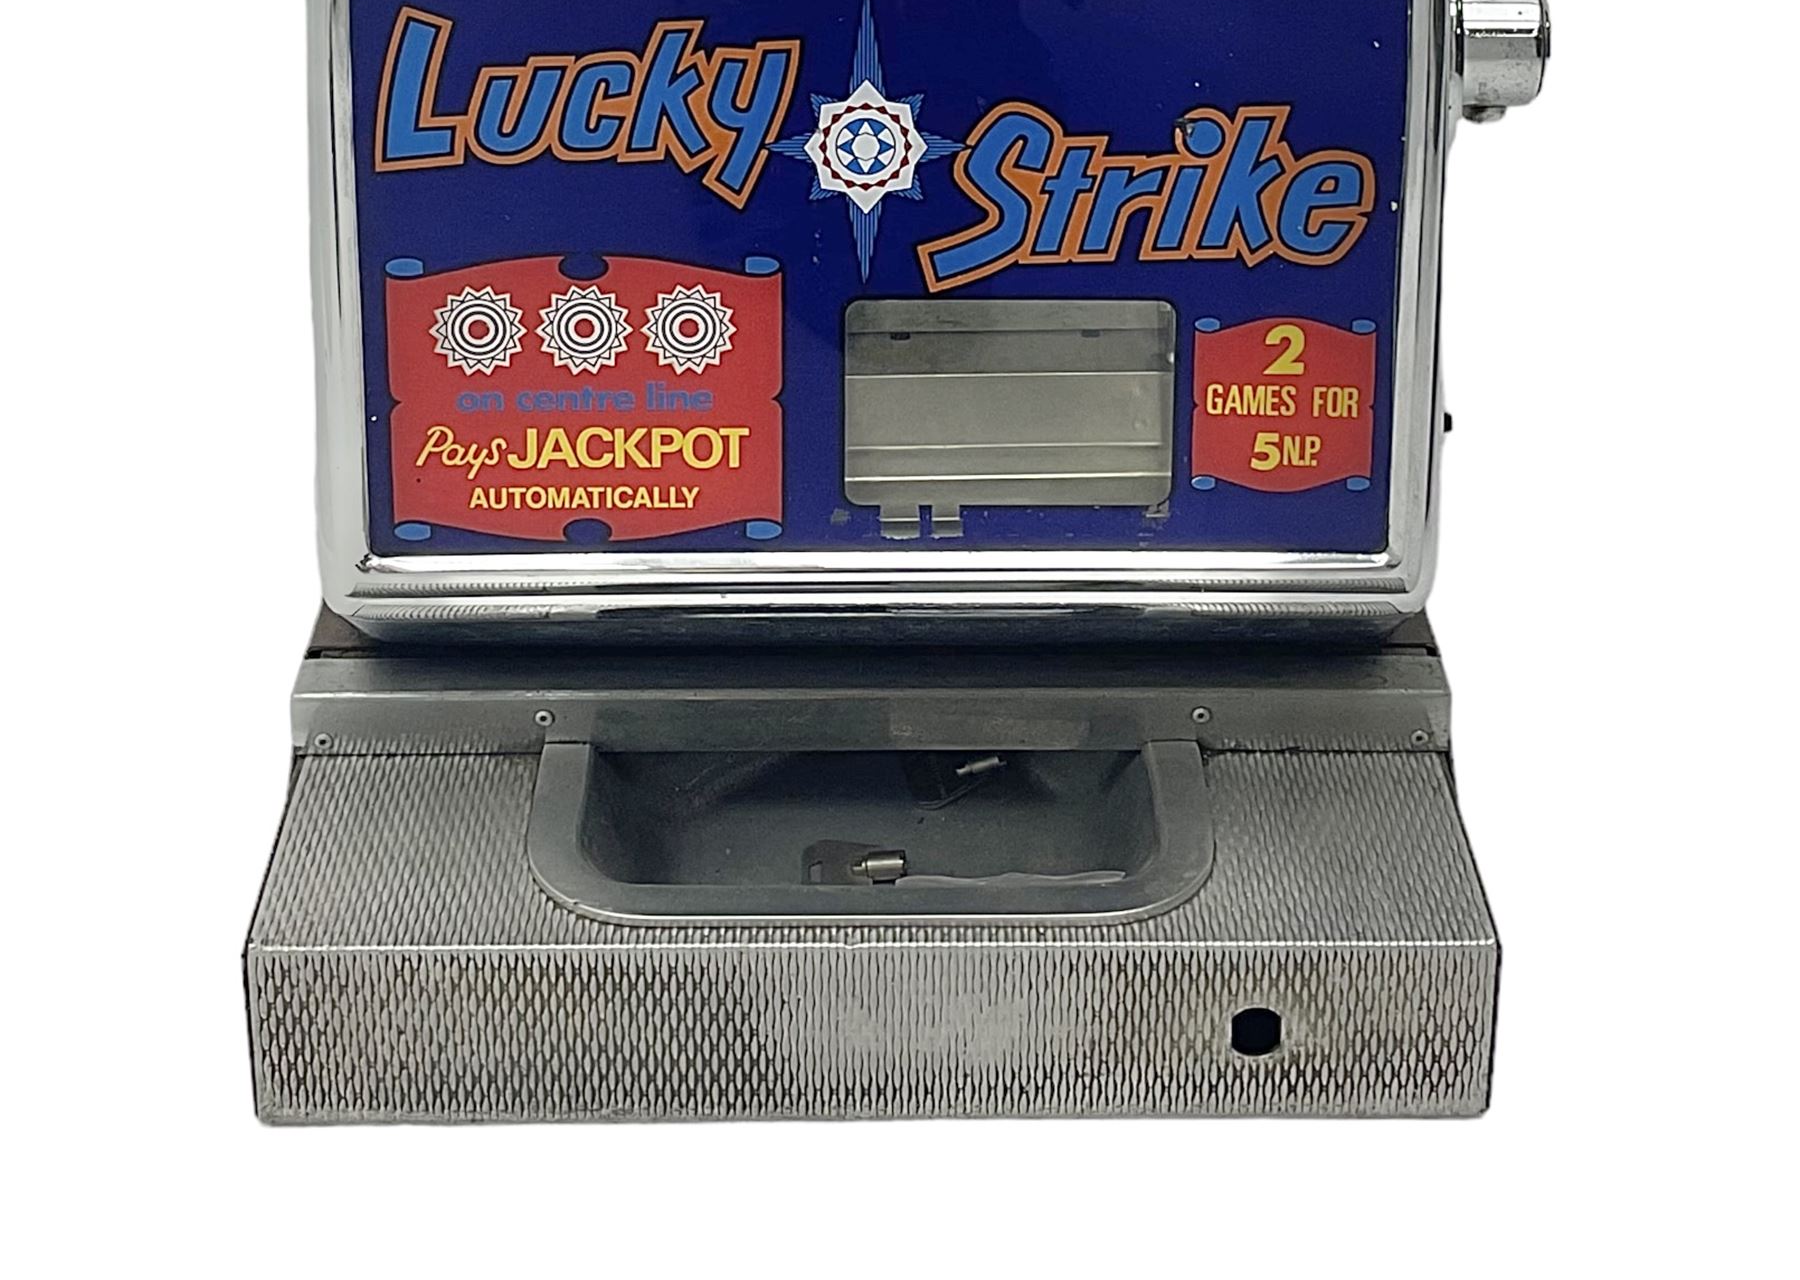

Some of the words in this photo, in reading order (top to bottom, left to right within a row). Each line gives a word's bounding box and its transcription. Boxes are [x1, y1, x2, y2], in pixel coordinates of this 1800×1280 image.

[375, 6, 800, 210] Lucky
[918, 101, 1376, 294] Strike
[1262, 324, 1306, 375] 2
[456, 389, 504, 413] on
[516, 386, 635, 412] centre
[645, 382, 714, 411] line
[1206, 383, 1297, 417] GAMES
[1312, 386, 1360, 418] FOR
[415, 425, 508, 480] Pays
[507, 426, 750, 470] JACKPOT
[468, 486, 700, 511] AUTOMATICALLY
